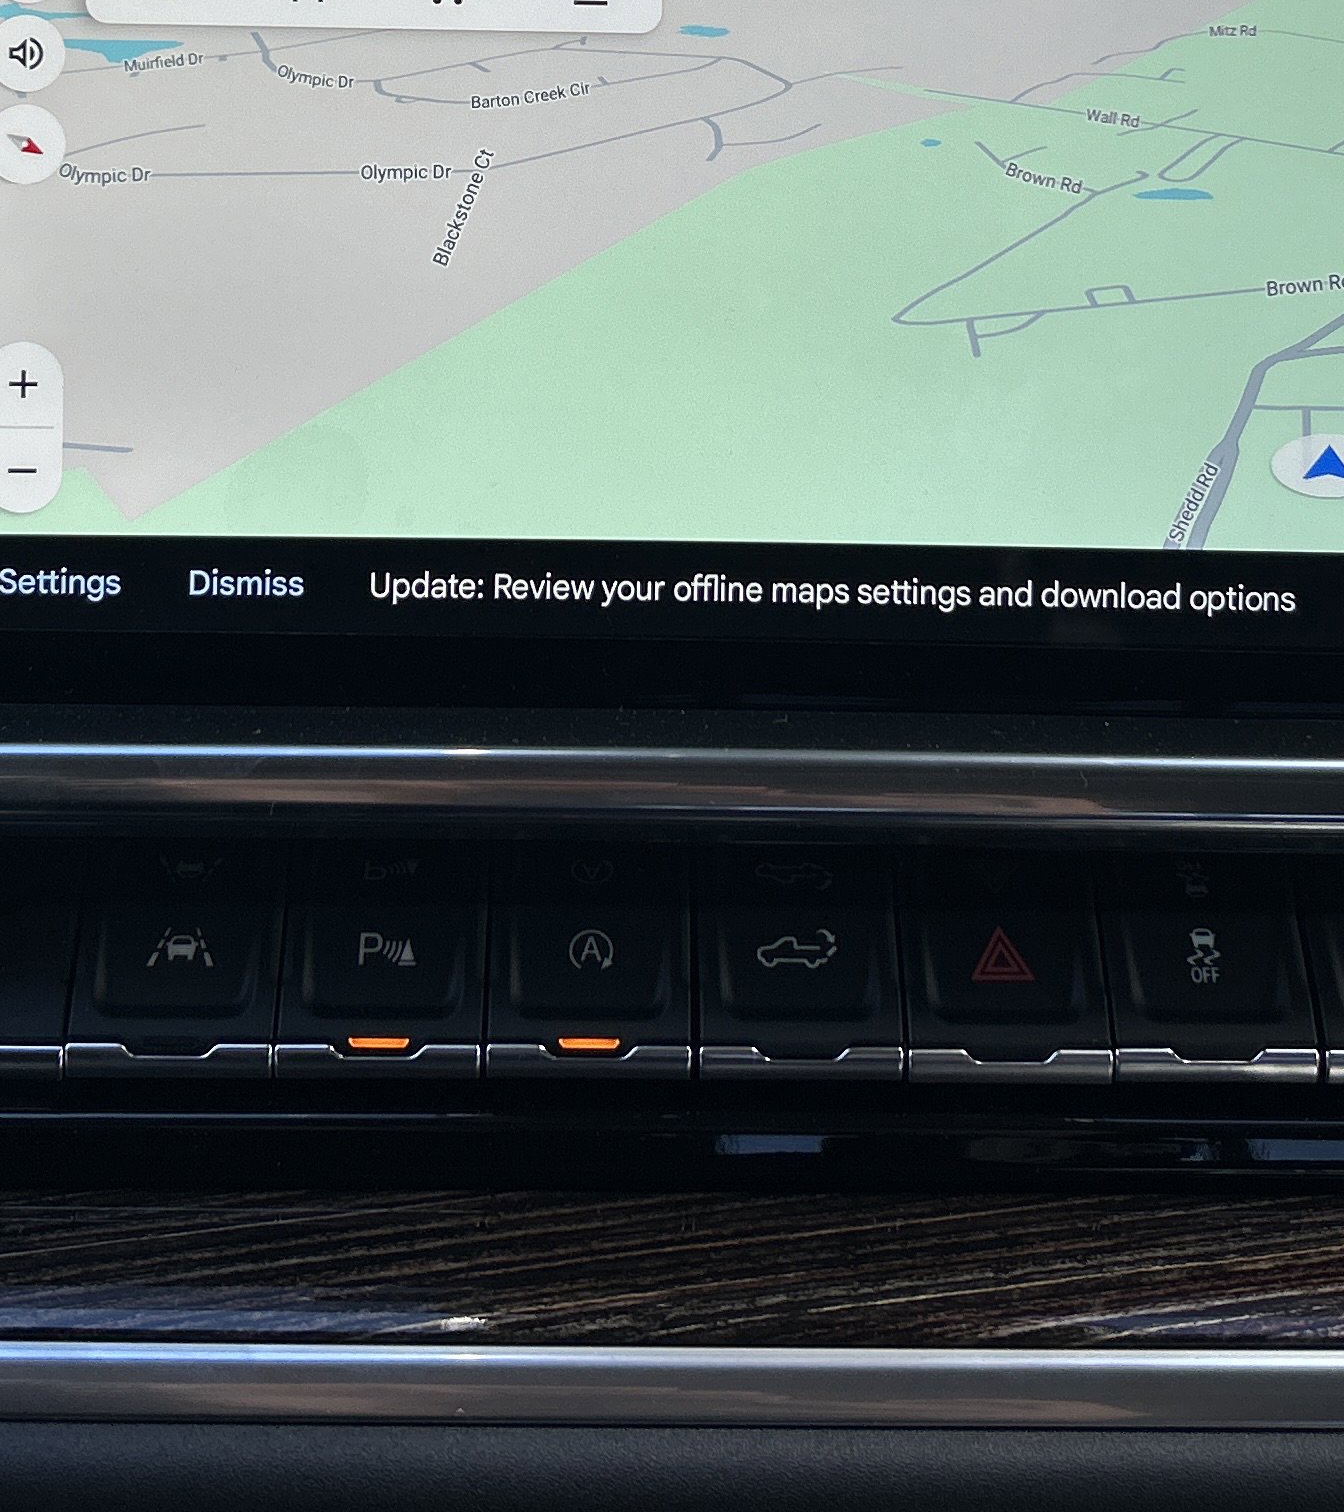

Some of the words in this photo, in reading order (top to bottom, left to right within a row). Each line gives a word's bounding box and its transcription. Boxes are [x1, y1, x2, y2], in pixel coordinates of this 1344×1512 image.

[1209, 25, 1237, 37] Mitz
[1239, 25, 1257, 37] Rd
[124, 54, 186, 72] Muirfield
[188, 53, 205, 66] Dr
[277, 64, 335, 88] Olympic
[338, 75, 355, 89] Dr
[471, 95, 521, 110] Barton
[524, 85, 567, 105] Creek
[1086, 108, 1118, 125] Wall
[1120, 114, 1141, 128] Rd
[58, 162, 127, 186] Olympic
[132, 167, 152, 182] Dr
[360, 164, 428, 183] Olympic
[433, 165, 452, 179] Dr
[1005, 162, 1057, 188] Brown
[1059, 177, 1084, 194] Rd
[432, 171, 485, 267] Blackstone
[473, 148, 496, 170] Ct
[1266, 278, 1324, 296] Brown
[1168, 487, 1205, 543] Shedd
[1196, 461, 1219, 488] Rd
[189, 568, 305, 596] Dismiss
[370, 571, 485, 605] Update:
[494, 572, 595, 600] Review
[601, 578, 665, 607] your
[673, 573, 763, 602] offline
[772, 580, 850, 610] maps
[857, 578, 971, 612] settings
[979, 580, 1032, 608] and
[1041, 580, 1181, 610] download
[1189, 584, 1296, 617] options
[1191, 967, 1220, 984] OFF
